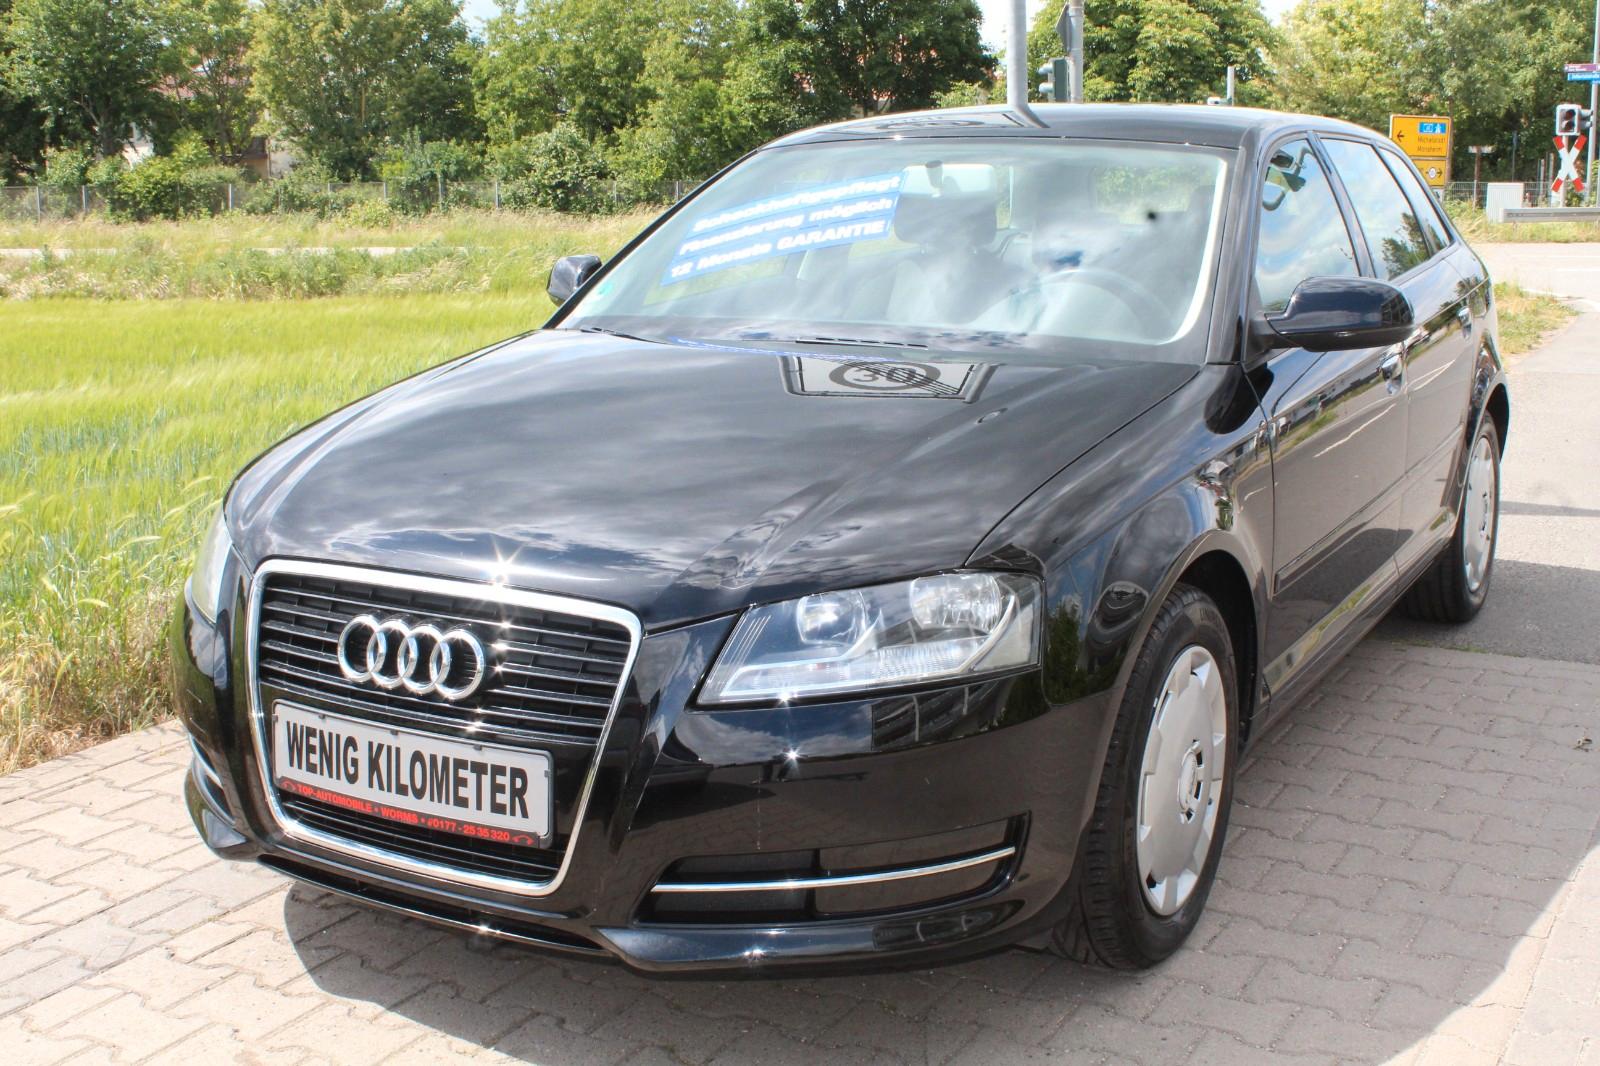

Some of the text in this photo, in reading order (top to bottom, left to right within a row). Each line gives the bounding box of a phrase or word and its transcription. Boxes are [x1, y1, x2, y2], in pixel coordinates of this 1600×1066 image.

[809, 198, 893, 222] möglich
[671, 220, 887, 278] 12 Monate GARANTIE
[286, 720, 529, 819] WENIG KILOMETER
[298, 783, 373, 813] TOP-AUTOMOBILE
[381, 807, 419, 824] WORMS
